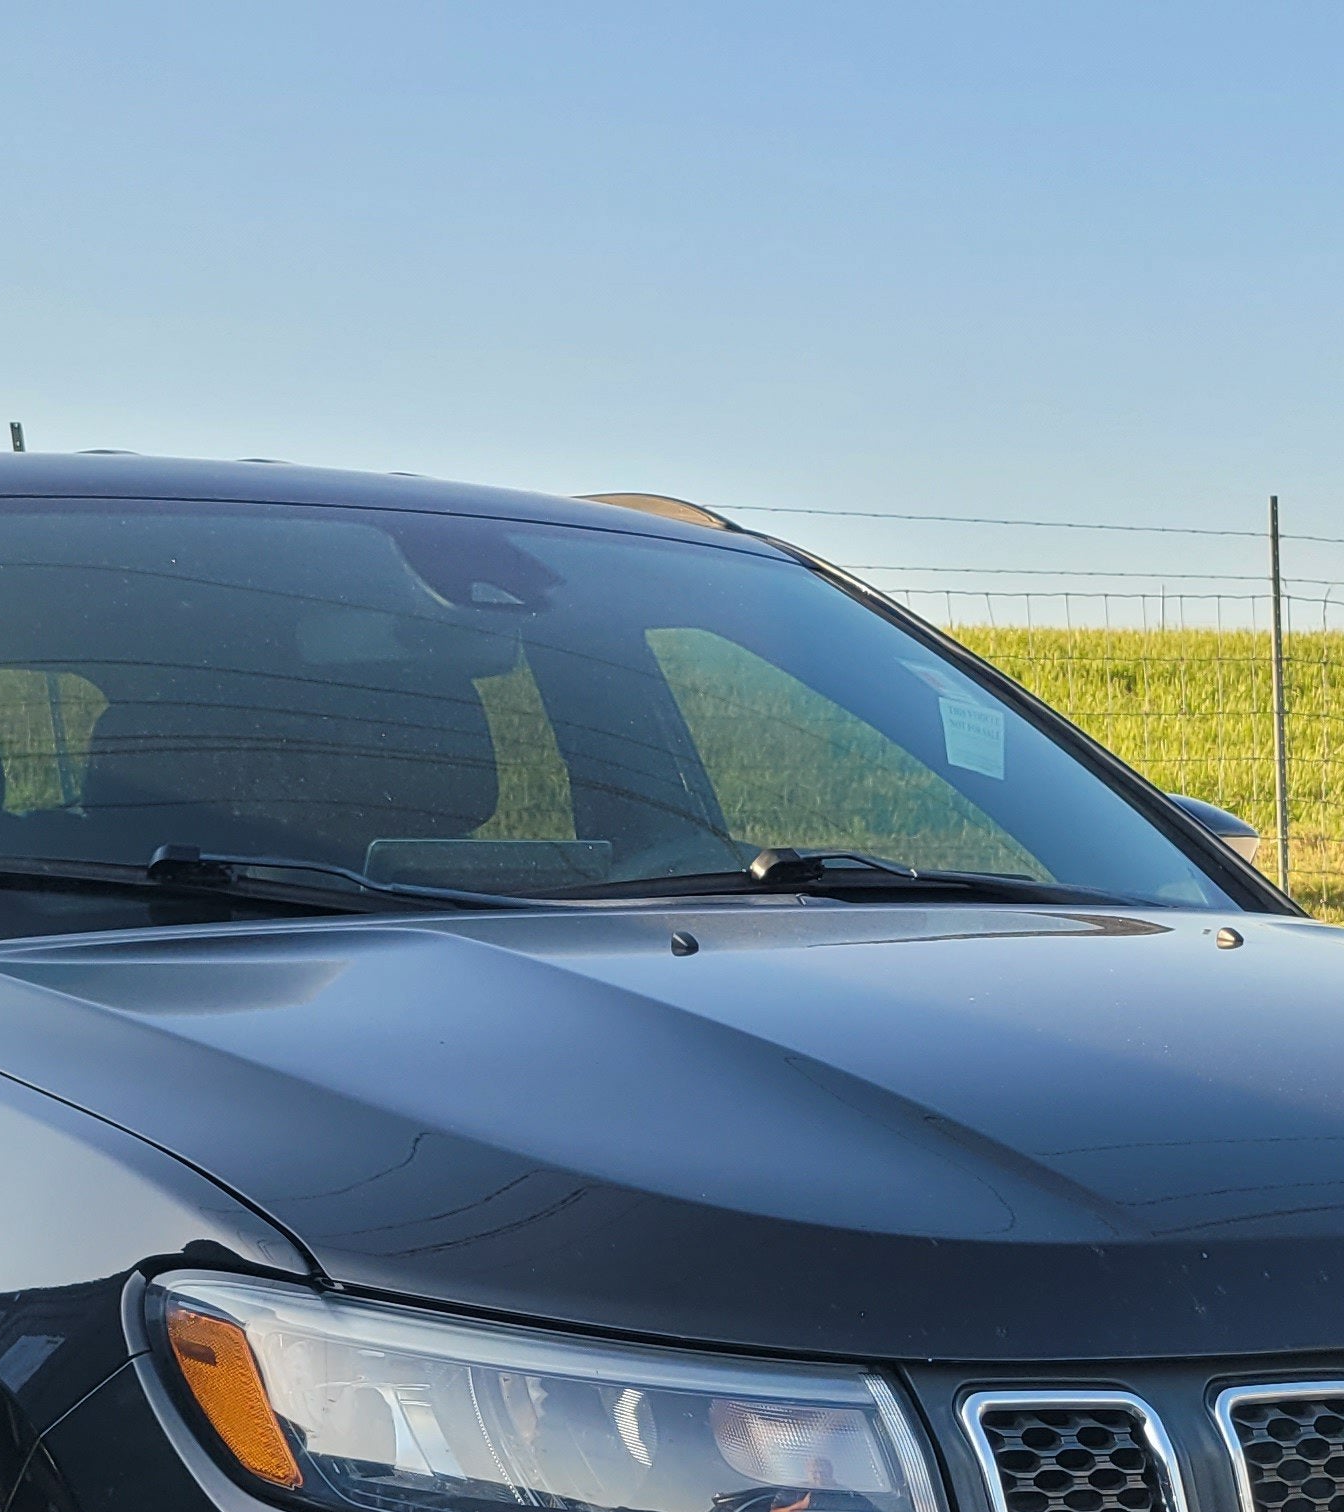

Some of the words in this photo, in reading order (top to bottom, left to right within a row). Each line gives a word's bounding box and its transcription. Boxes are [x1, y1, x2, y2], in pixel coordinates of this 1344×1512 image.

[967, 709, 999, 726] VEHICLE
[949, 718, 965, 729] NOT
[967, 724, 981, 733] FOR
[982, 727, 1000, 740] SALE
